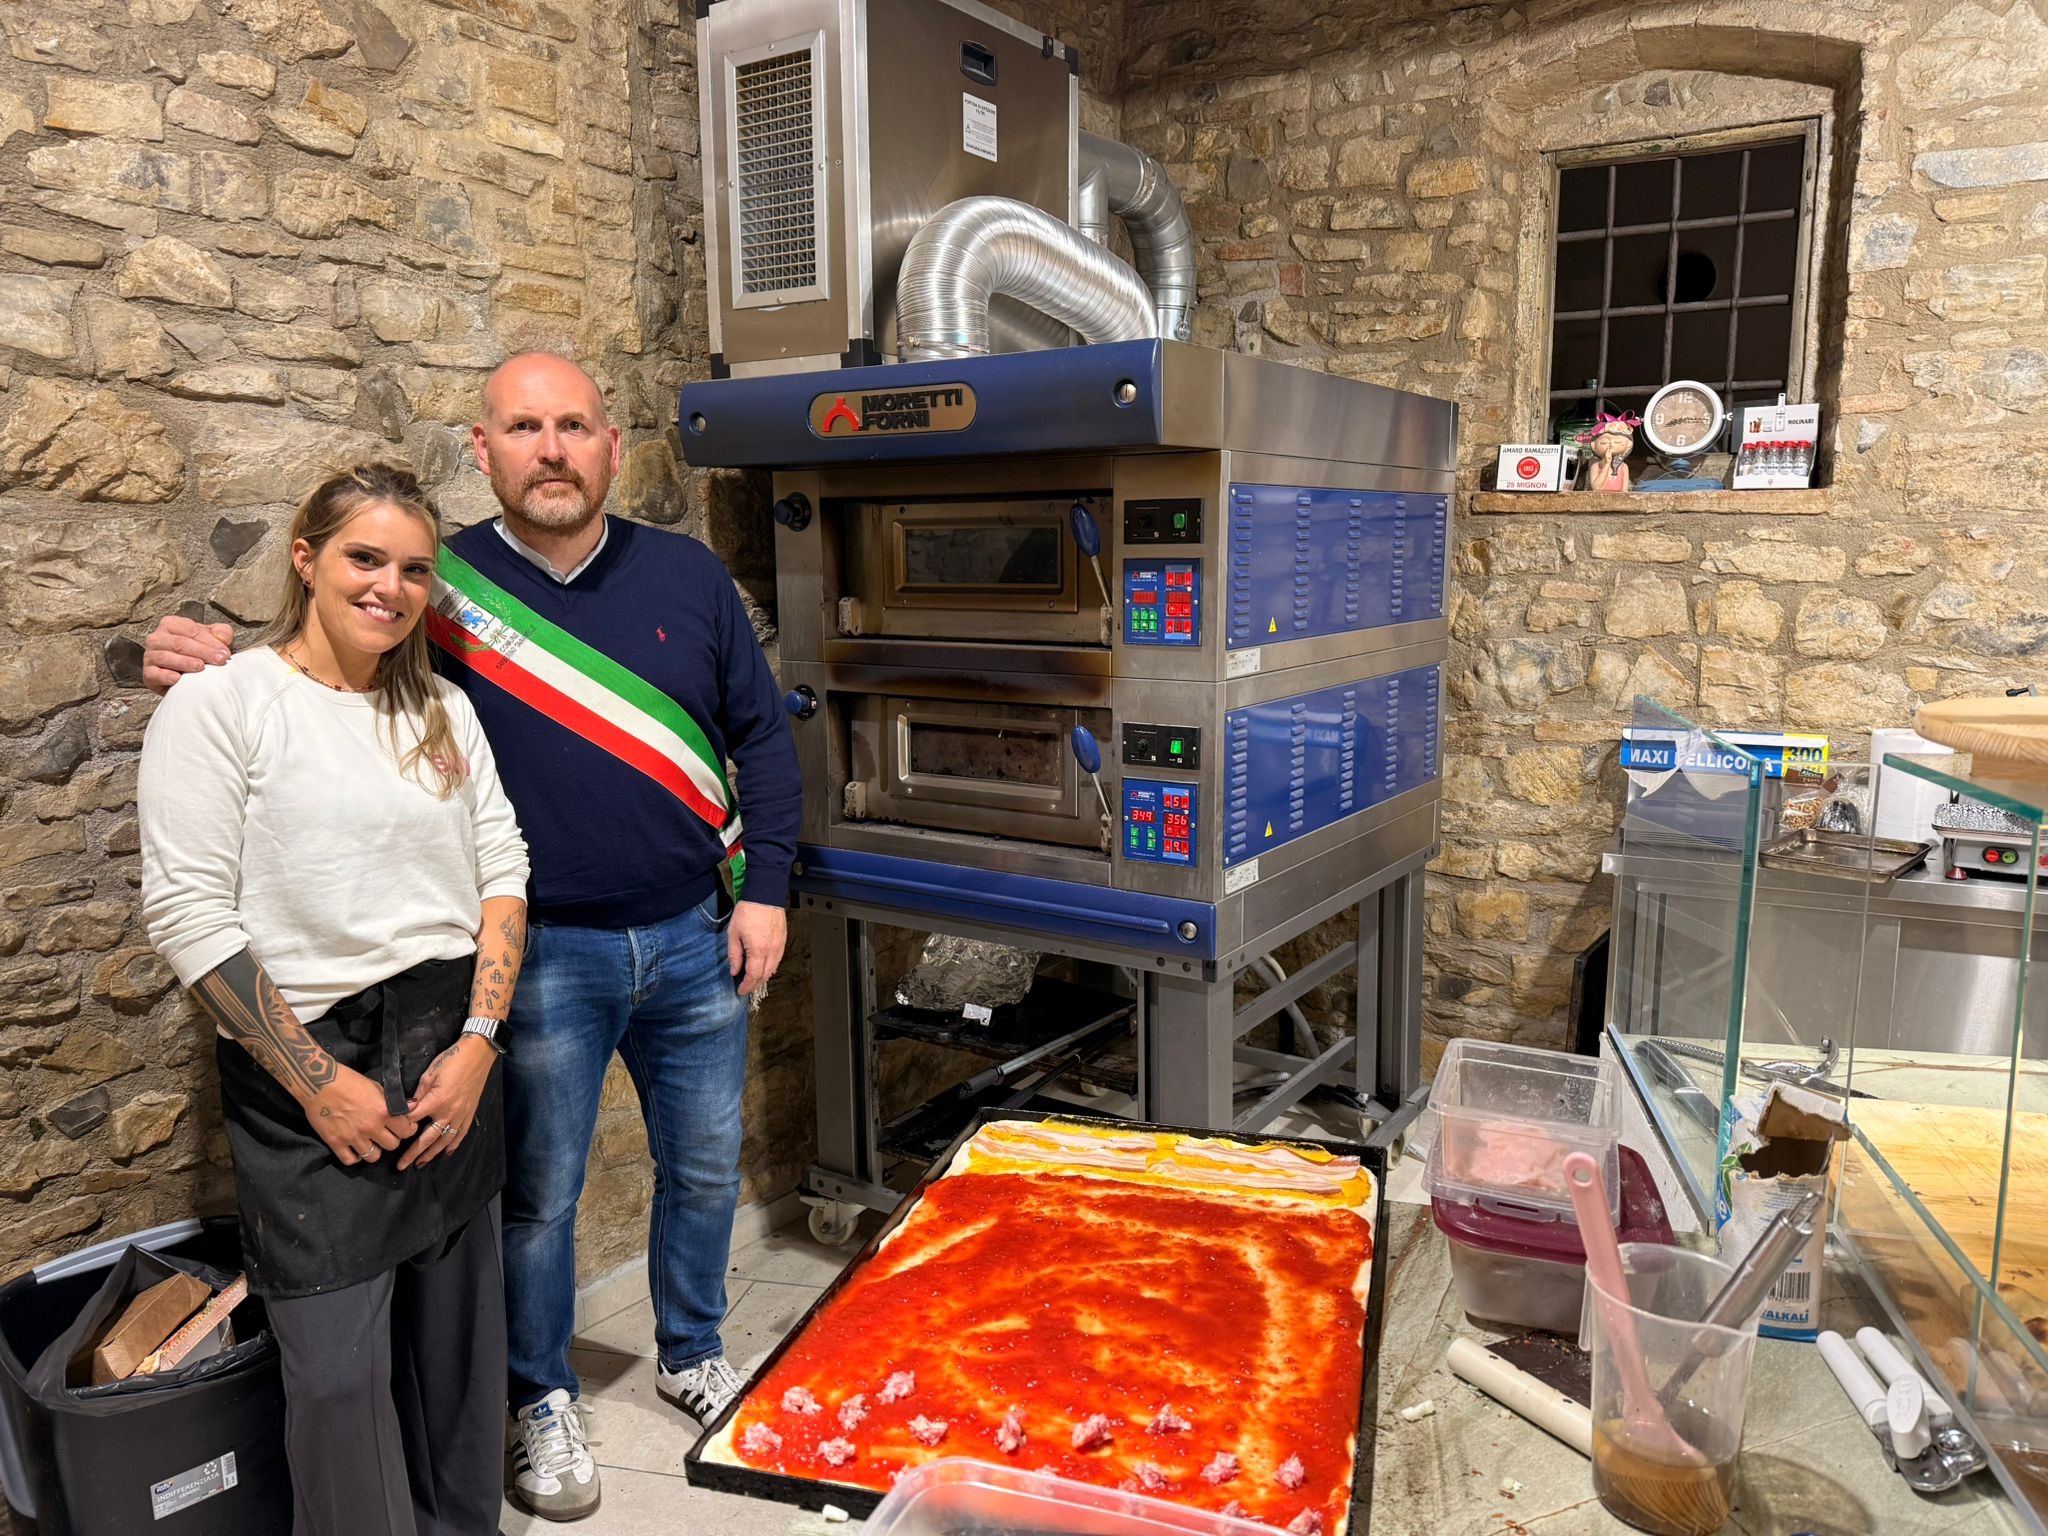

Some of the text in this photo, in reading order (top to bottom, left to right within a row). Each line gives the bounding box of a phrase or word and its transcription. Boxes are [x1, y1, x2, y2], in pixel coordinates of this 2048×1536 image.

[861, 388, 963, 413] MORETTI
[1679, 391, 1693, 404] 12
[861, 409, 931, 431] FORNI
[1655, 413, 1664, 425] 9
[1676, 434, 1686, 446] 6
[499, 632, 520, 653] COMUNE
[1630, 748, 1669, 765] MAXI
[1674, 751, 1774, 773] ELLICOA
[1788, 746, 1823, 762] 300
[1173, 796, 1180, 807] 5
[1132, 810, 1187, 826] 349 356
[157, 1472, 220, 1502] INDIFFERENZIATA
